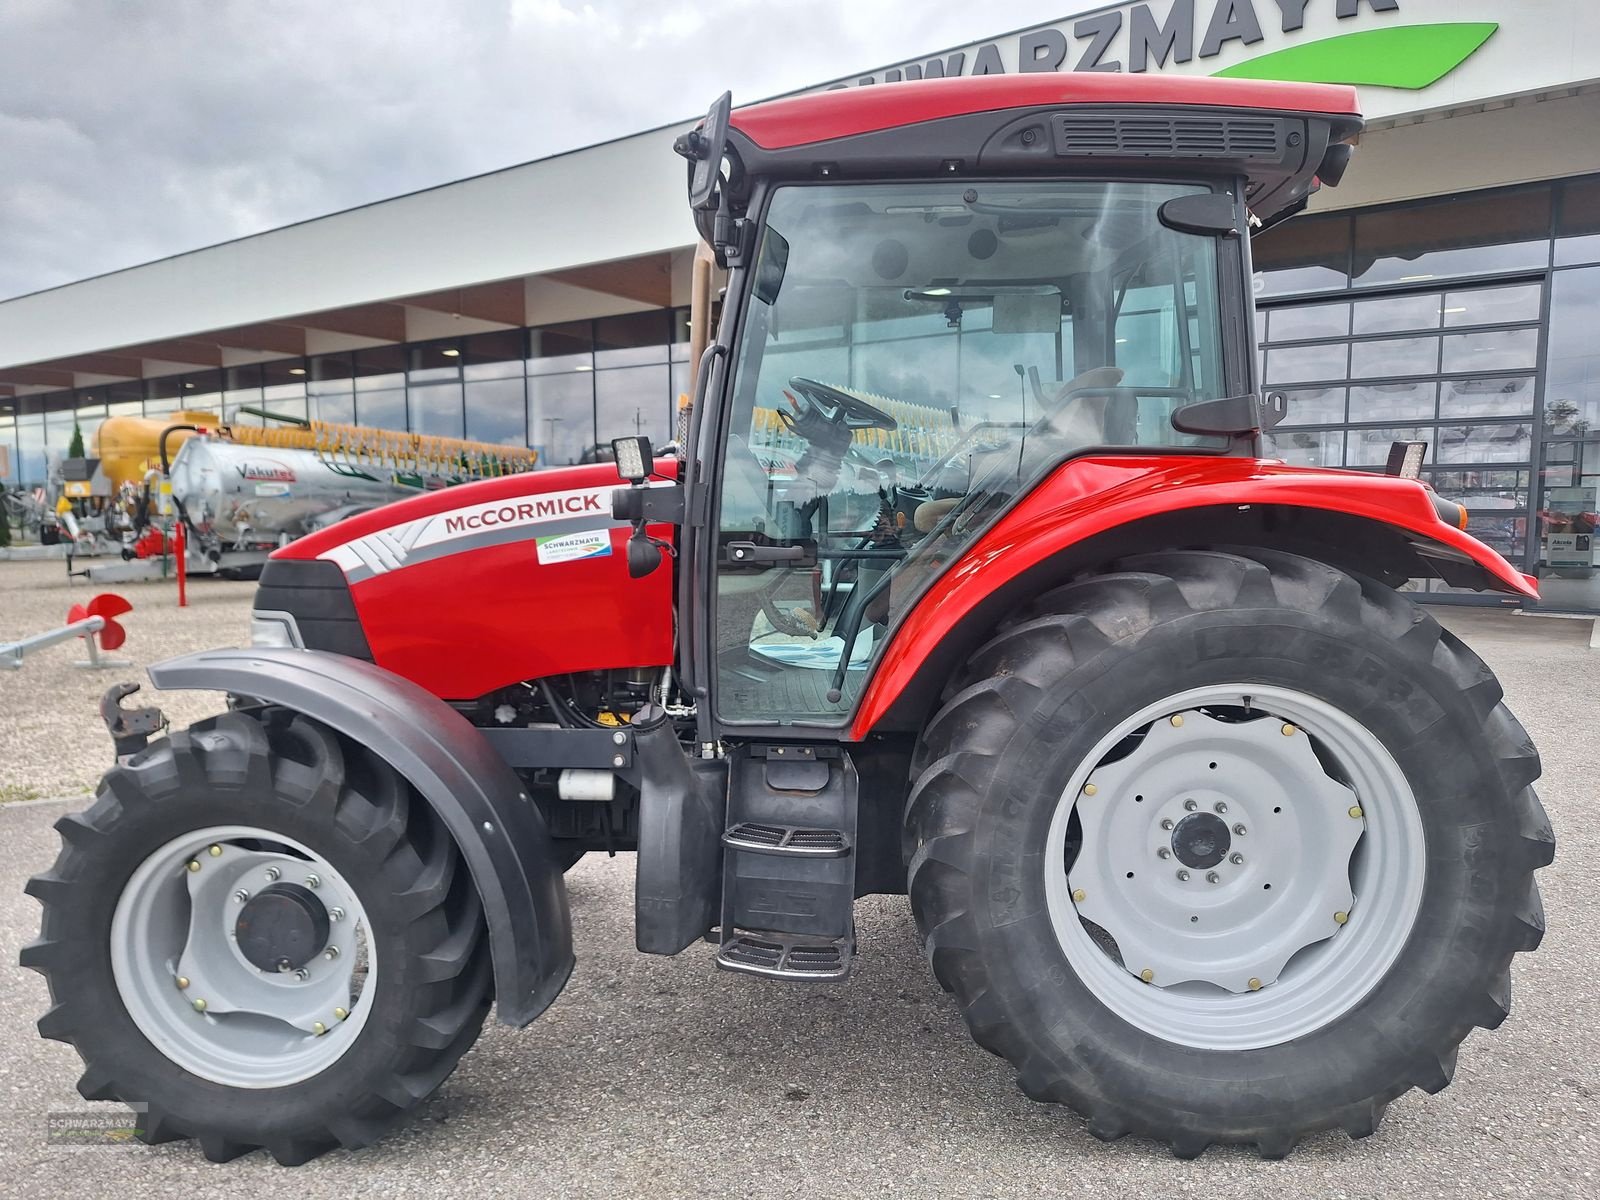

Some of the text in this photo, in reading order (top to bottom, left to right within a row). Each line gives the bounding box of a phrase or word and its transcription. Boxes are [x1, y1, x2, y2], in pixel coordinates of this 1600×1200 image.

[827, 0, 1399, 90] ARZMAY
[445, 494, 601, 534] McCORMICK
[544, 537, 600, 550] SCHWARZMAYR
